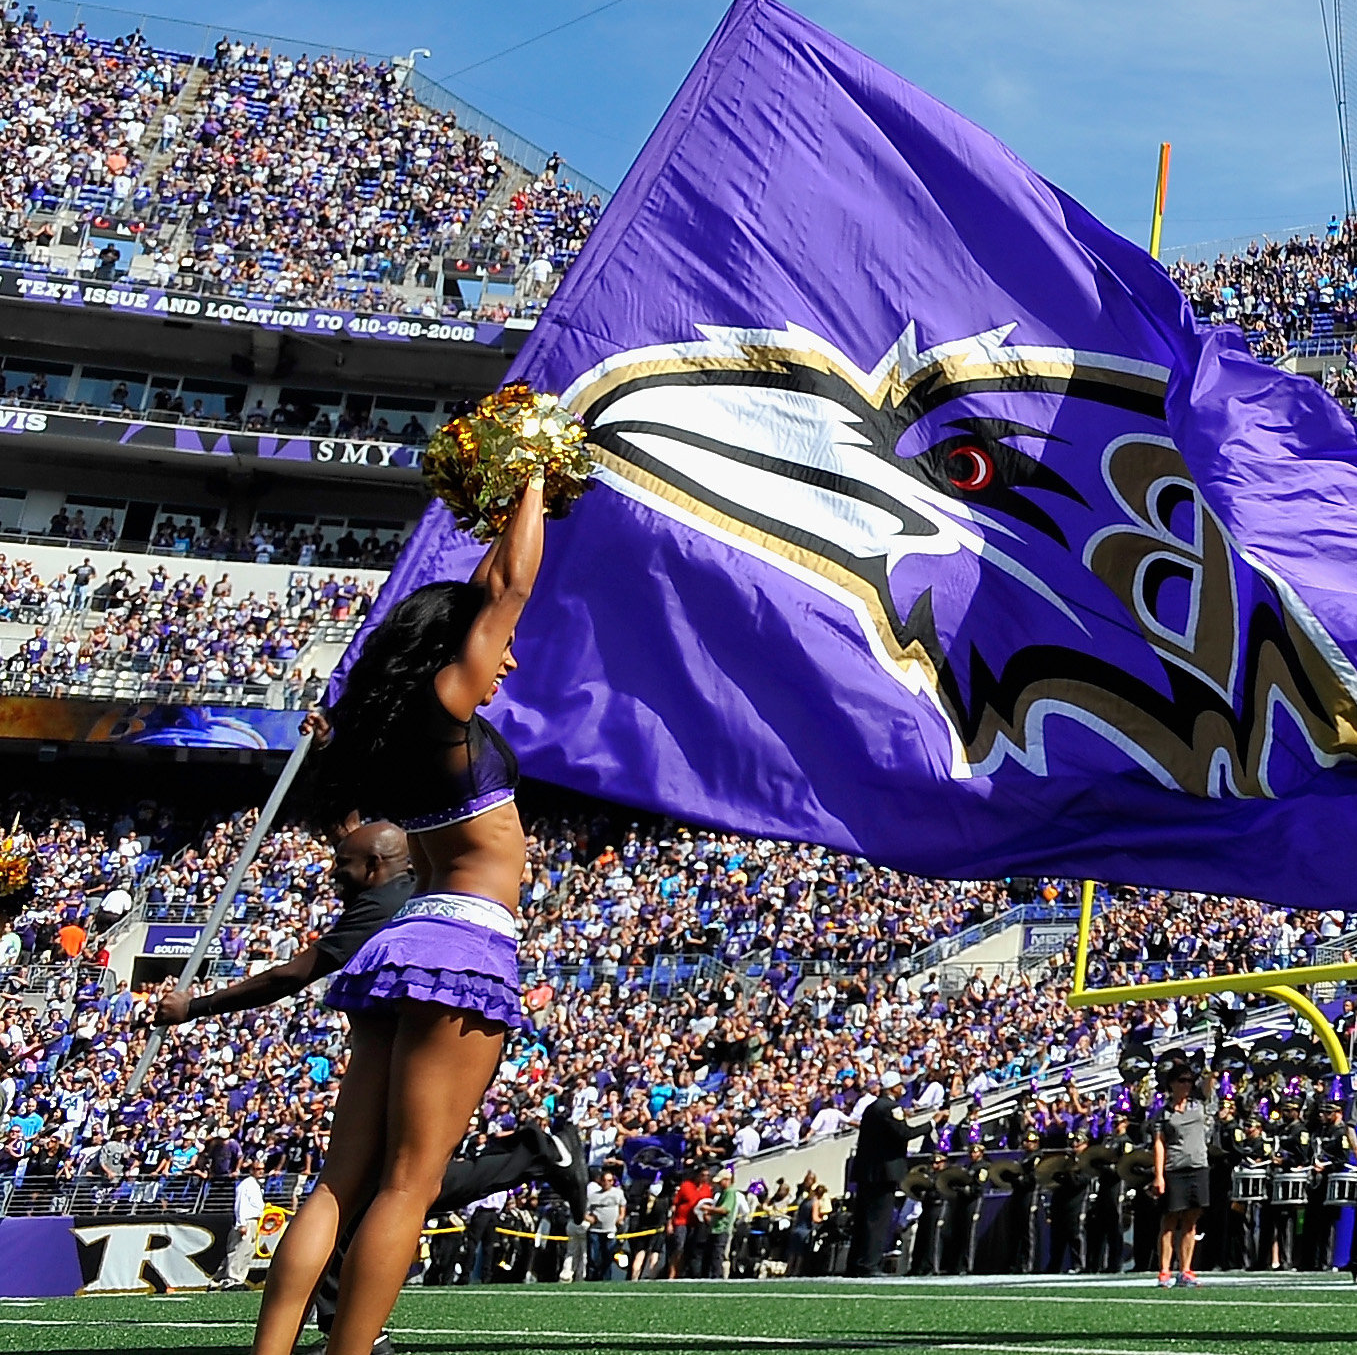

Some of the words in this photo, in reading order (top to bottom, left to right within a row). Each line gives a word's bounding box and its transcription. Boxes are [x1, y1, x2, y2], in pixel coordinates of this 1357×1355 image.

[16, 278, 79, 300] TEXT
[83, 286, 149, 309] ISSUE
[154, 295, 201, 316] AND
[205, 301, 309, 328] LOCATION
[314, 314, 344, 331] TO
[348, 317, 476, 343] 410-988-2008
